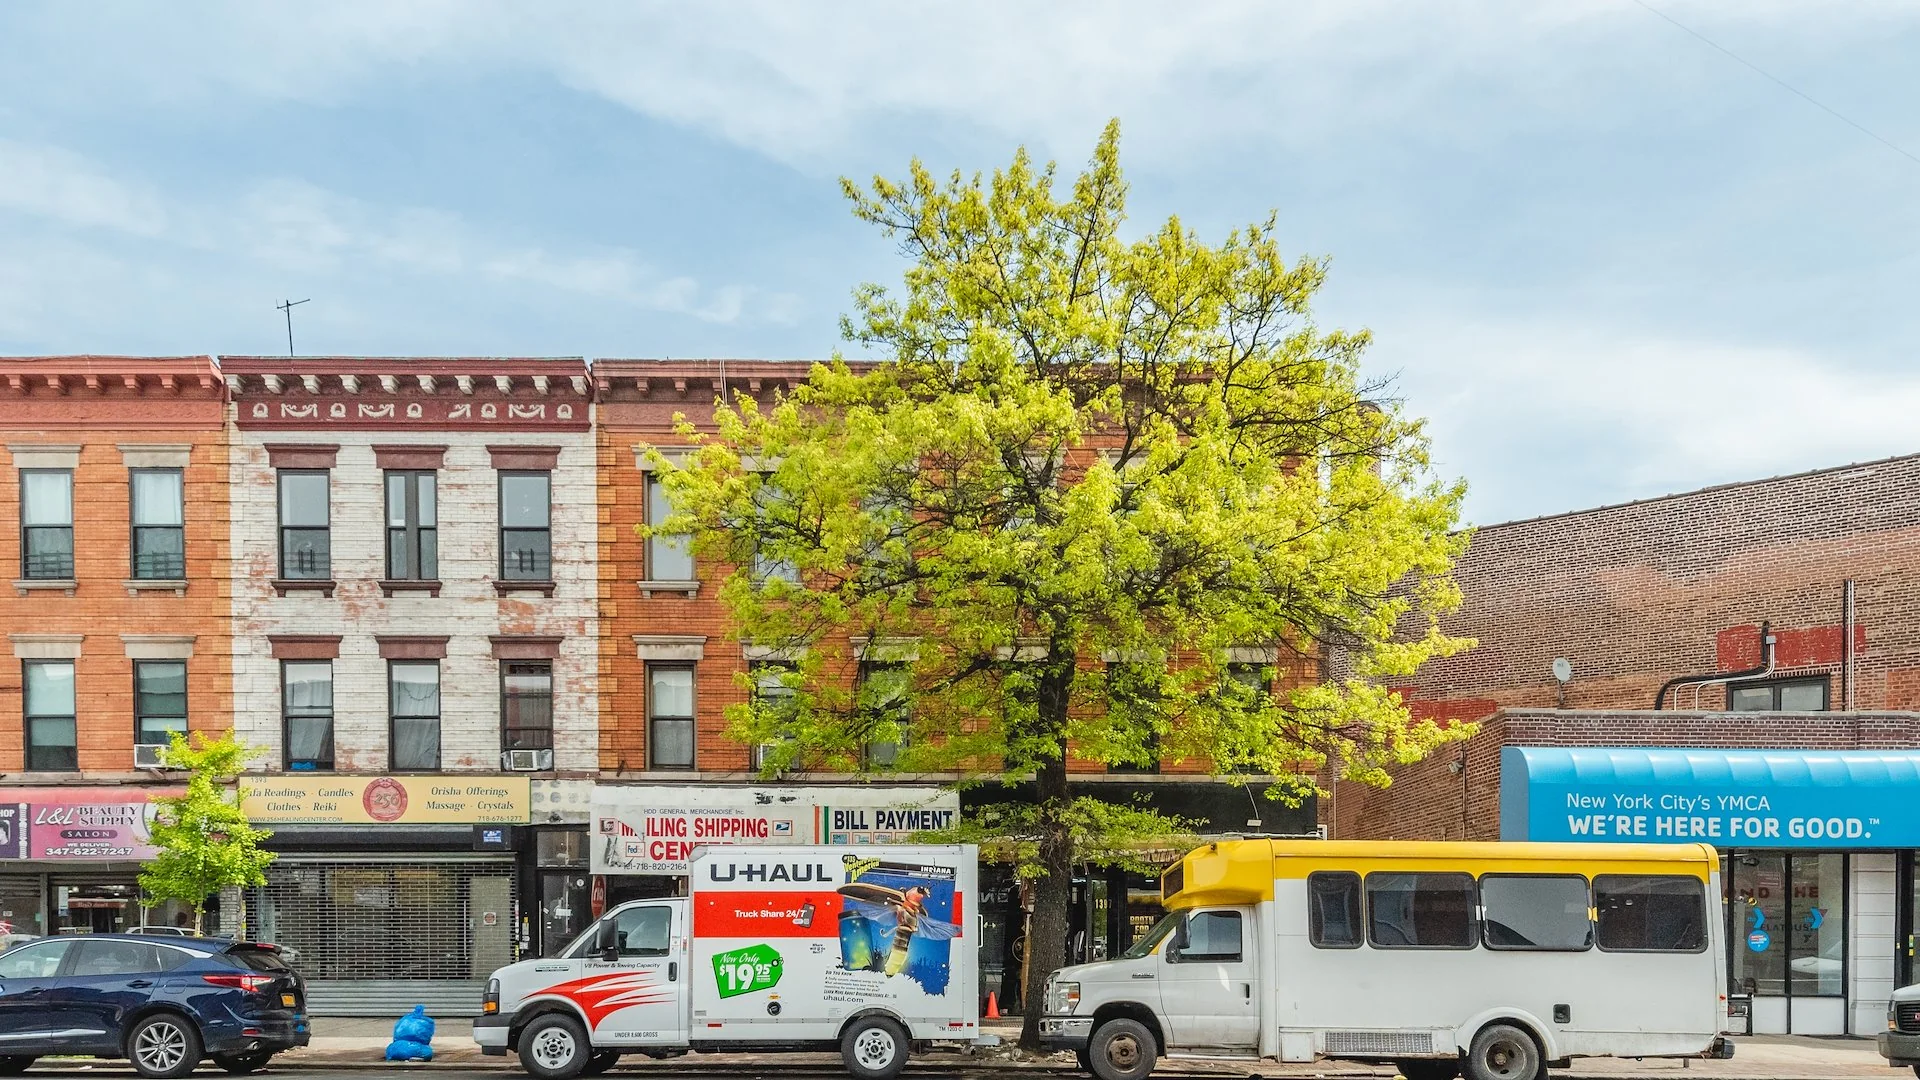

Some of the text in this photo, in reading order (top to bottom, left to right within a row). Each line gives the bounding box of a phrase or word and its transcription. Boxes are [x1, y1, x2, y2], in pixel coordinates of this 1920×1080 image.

[264, 788, 306, 799] Readings
[318, 788, 354, 797] Candles
[431, 786, 509, 797] Orisha Offerings
[374, 792, 400, 809] 256
[1567, 792, 1771, 813] New York City's YMCA
[79, 806, 138, 816] BEAUTY
[267, 802, 337, 811] Clothes Reiki
[426, 800, 514, 812] Massage Crystals
[35, 807, 74, 826] L&L
[80, 816, 138, 826] SUPPLY
[834, 810, 953, 830] BILL PAYMENT
[621, 817, 687, 837] MILING
[694, 817, 768, 838] SHIPPING
[1567, 814, 1647, 836] WE'RE
[1656, 816, 1722, 837] HERE
[1730, 817, 1780, 838] FOR
[67, 830, 111, 838] SALON
[46, 847, 133, 856] 347-622-7247
[710, 863, 833, 882] U-HAUL
[920, 866, 951, 875] INDIANA
[1095, 899, 1112, 909] 1397
[734, 909, 807, 918] Truck Share 24/7
[1129, 915, 1154, 925] BOOTH
[1134, 925, 1150, 935] FOR
[720, 952, 760, 966] Now Only
[823, 995, 864, 1003] uhaul.com
